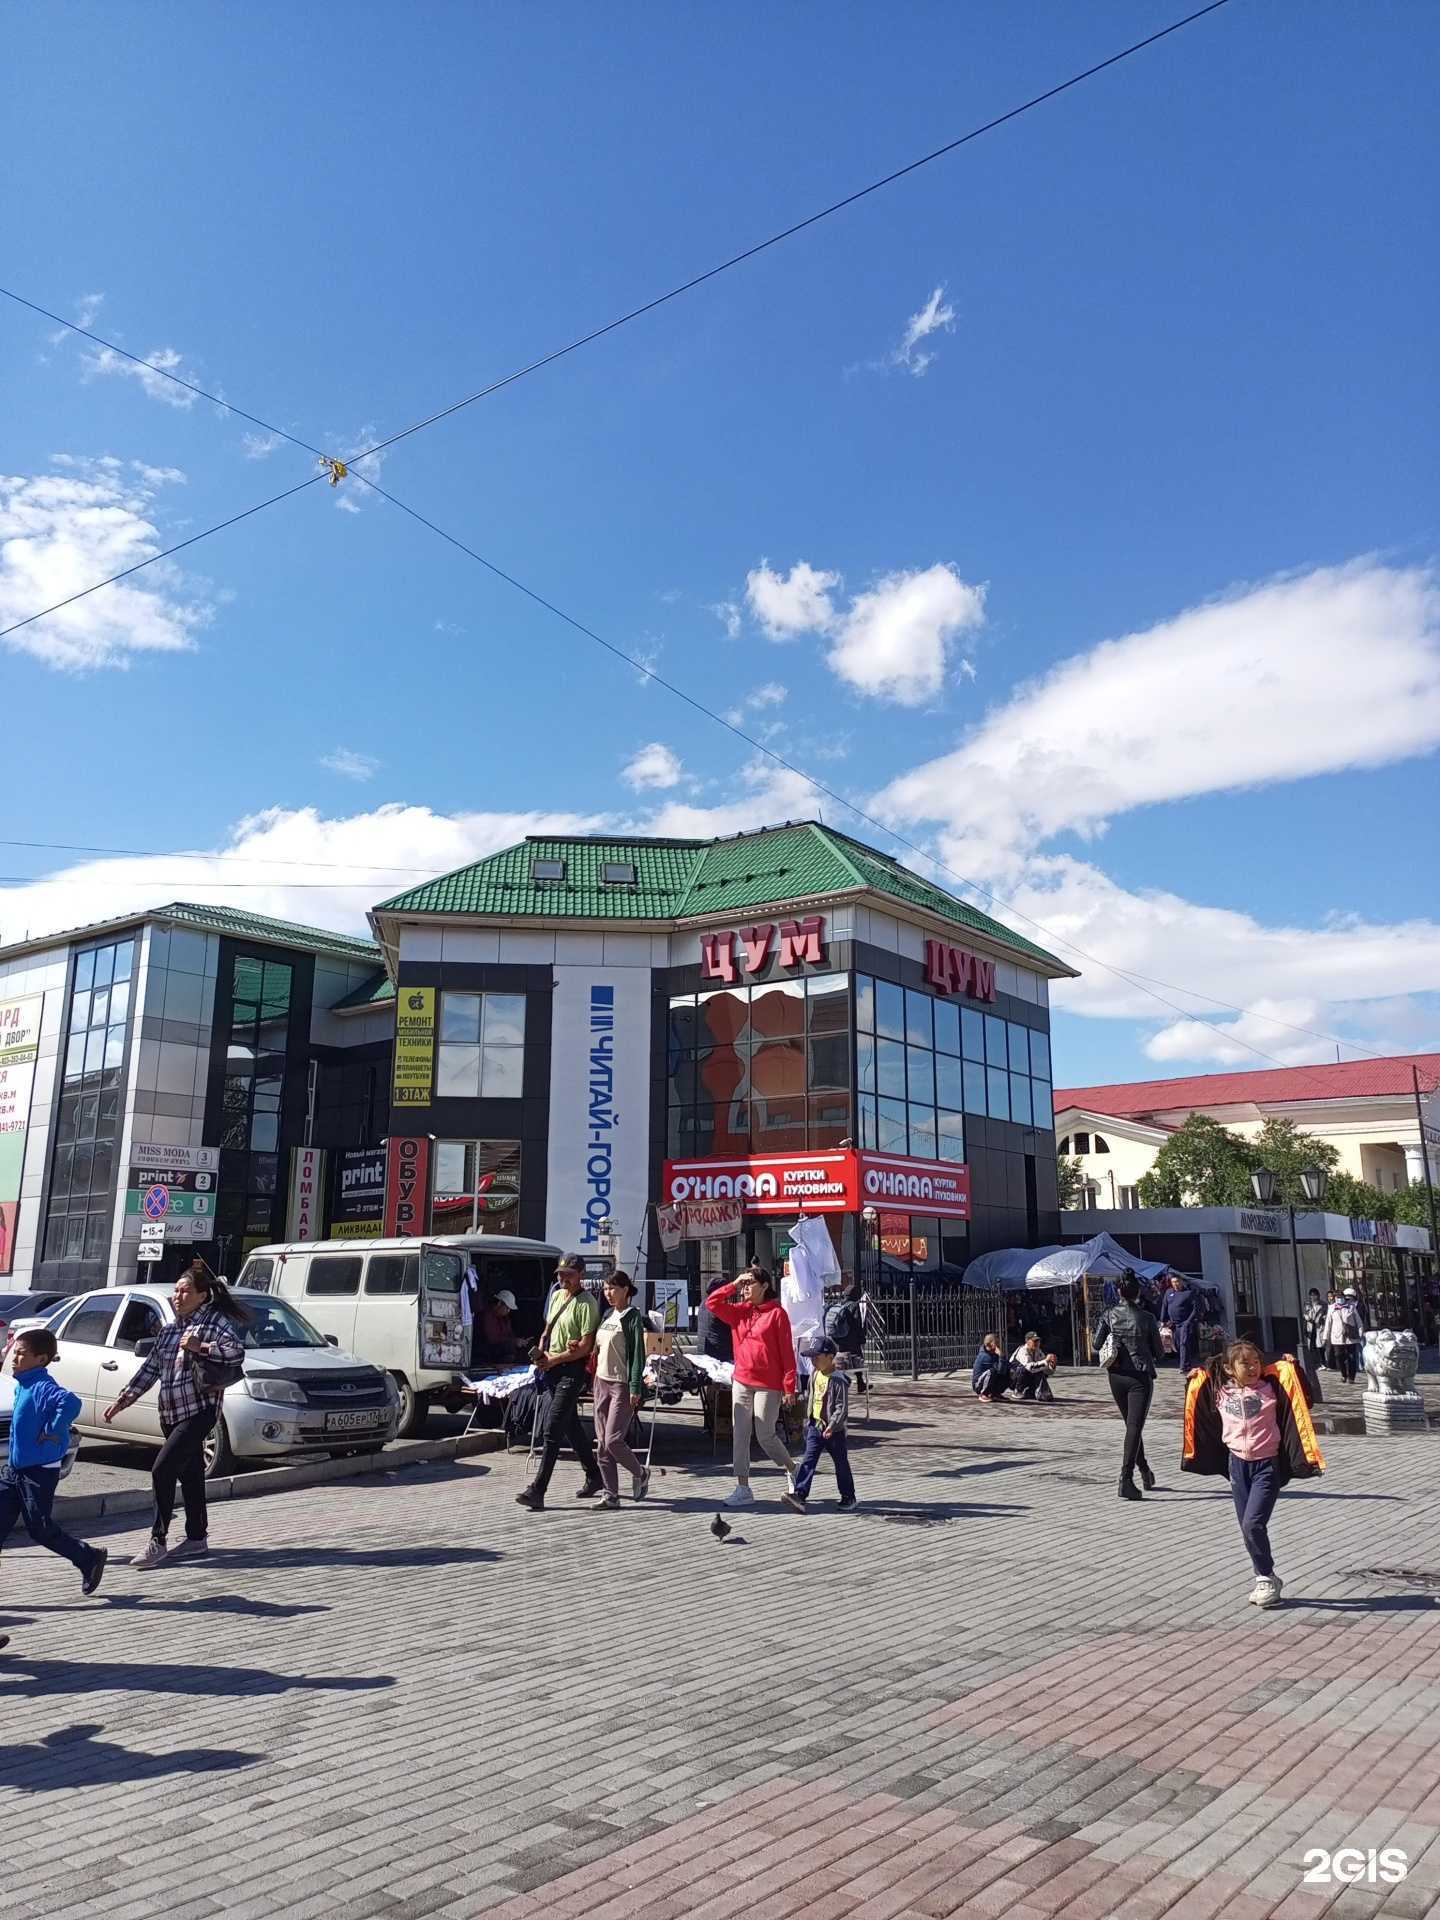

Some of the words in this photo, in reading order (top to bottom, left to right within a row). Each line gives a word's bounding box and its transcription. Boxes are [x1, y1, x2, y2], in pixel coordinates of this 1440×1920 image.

[701, 915, 825, 984] ЦУМ
[926, 939, 996, 1002] ЦУМ
[399, 1017, 432, 1026] РЕМОНТ
[400, 1037, 431, 1047] ТЕХНИКИ
[402, 1088, 430, 1101] ЭТАЖ
[580, 1035, 619, 1244] ЧИТАЙ-ГОРОД
[138, 1146, 161, 1155] MISS
[163, 1148, 190, 1158] MODA
[201, 1152, 208, 1161] 3
[139, 1170, 174, 1183] print
[200, 1176, 207, 1185] 2
[342, 1161, 383, 1190] print
[783, 1169, 825, 1182] КУРТКИ
[783, 1182, 844, 1196] ПУХОВИКИ
[934, 1178, 957, 1188] КУРТКИ
[935, 1190, 967, 1203] ПУХОВИКИ
